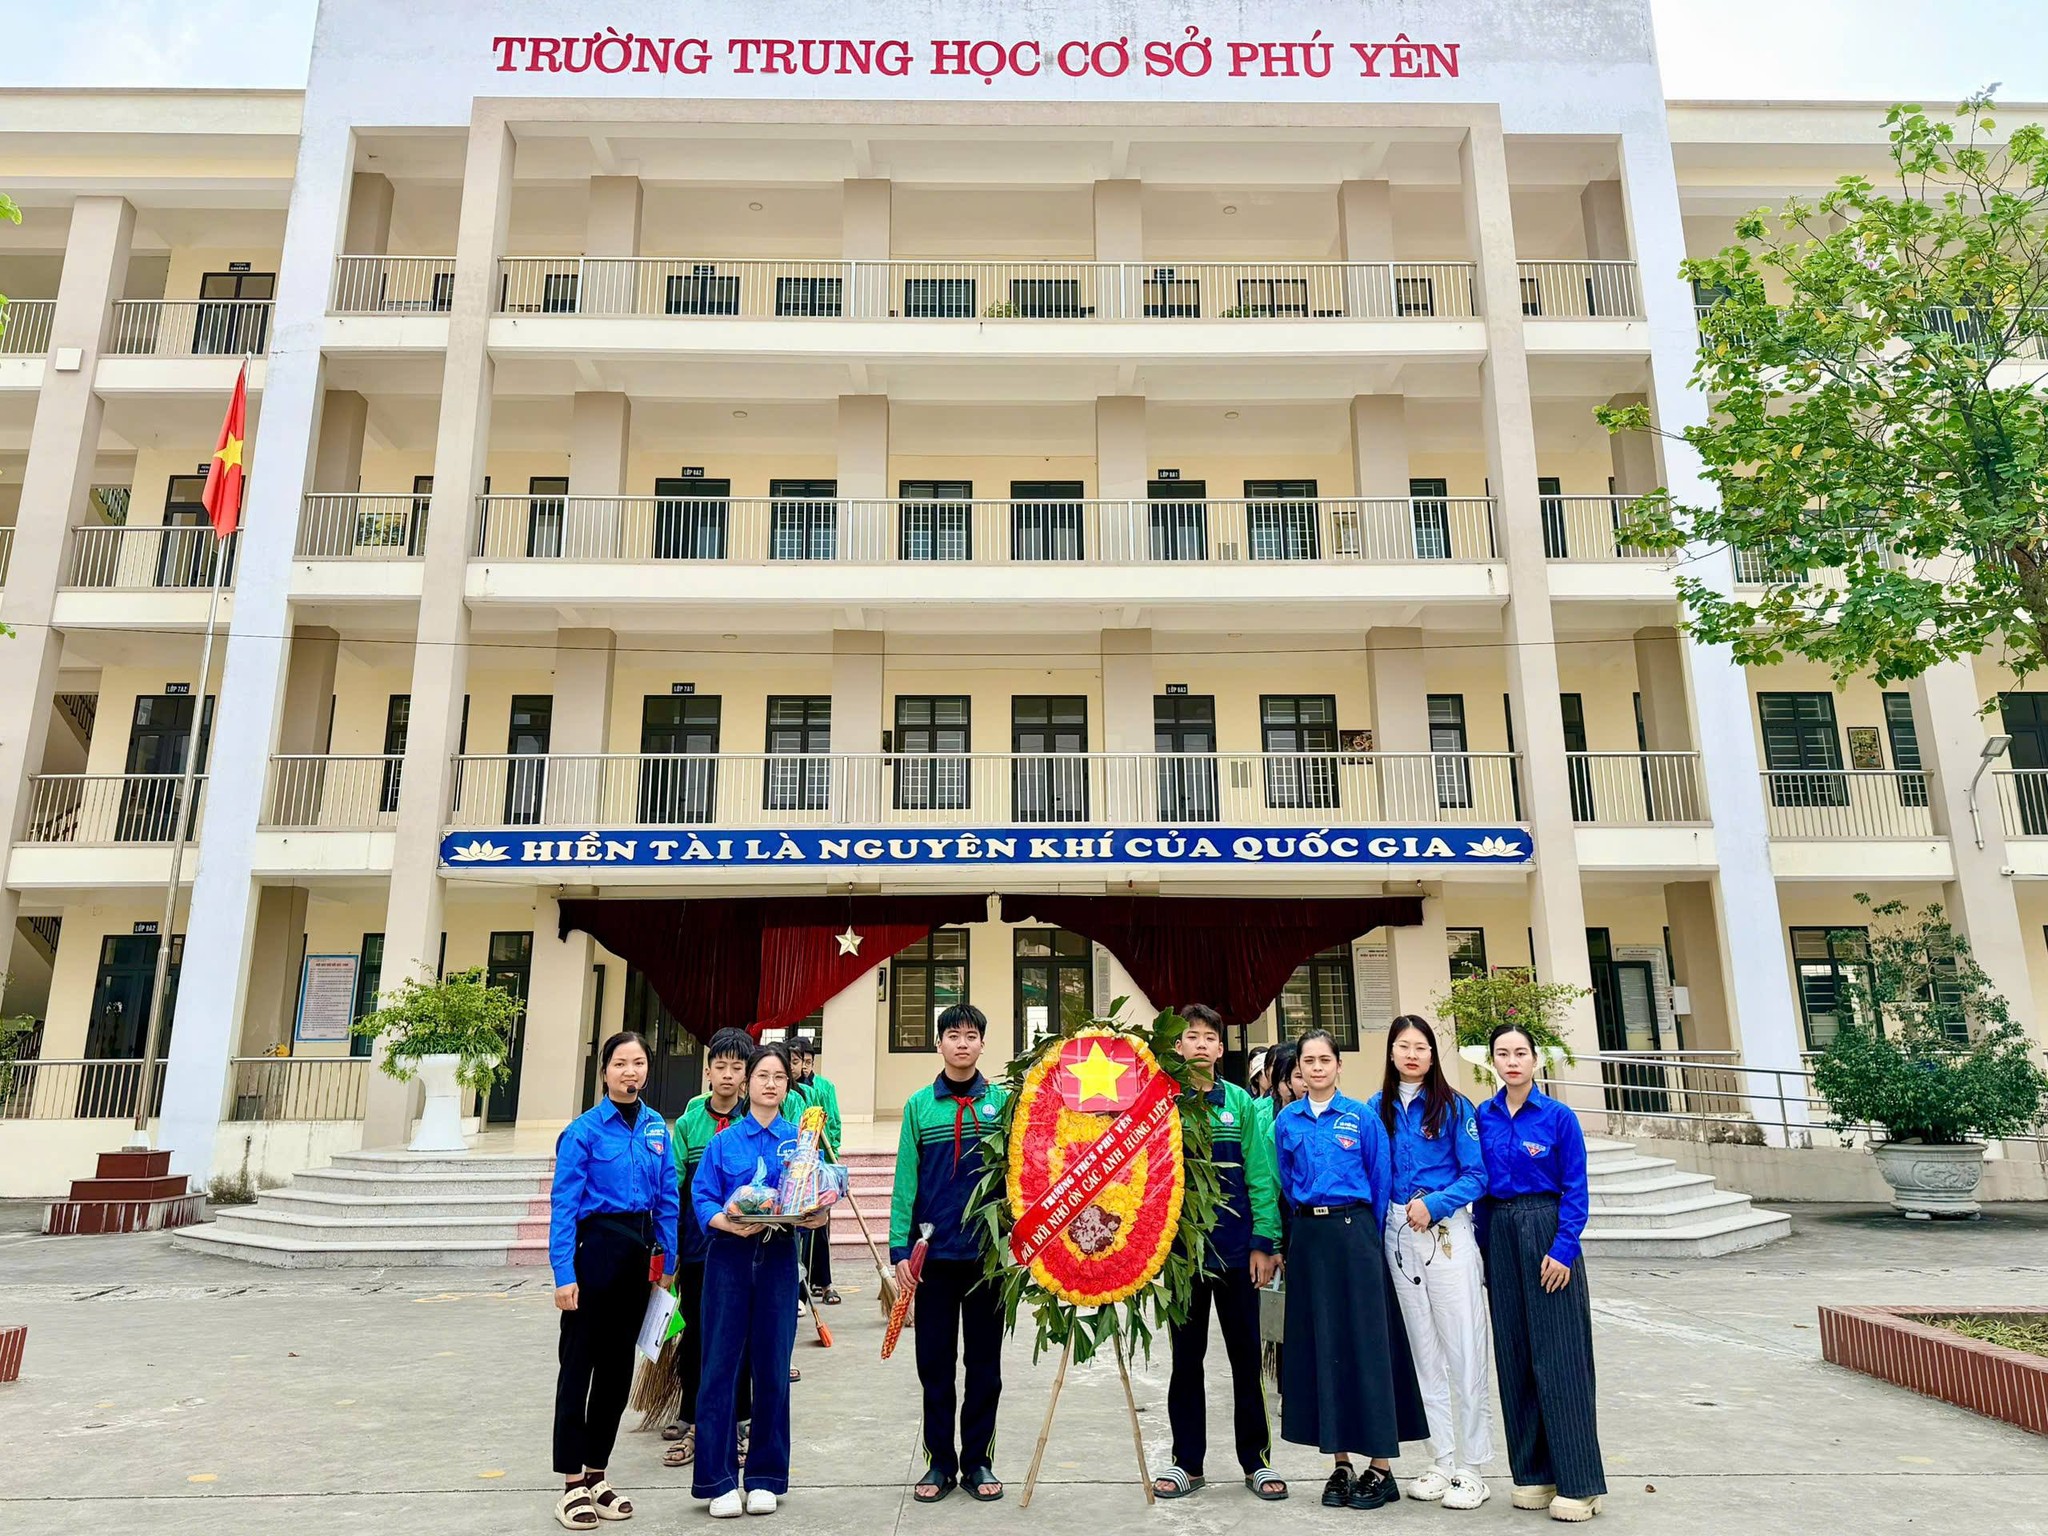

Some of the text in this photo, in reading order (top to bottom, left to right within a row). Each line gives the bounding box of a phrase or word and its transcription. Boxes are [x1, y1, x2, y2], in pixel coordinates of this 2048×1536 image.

[493, 26, 1461, 86] TRƯỜNG TRUNG HỌC CƠ SỞ PHÚ YÊN
[520, 828, 1456, 862] HIỀN TÀI LÀ NGUYÊN KHÍ CỦA QUỐC GIA
[1031, 1223, 1052, 1246] ĐỜI
[1082, 1169, 1103, 1192] CÁC
[1101, 1148, 1125, 1174] ANH
[1123, 1121, 1151, 1152] HÙNG
[1148, 1098, 1170, 1125] LIỆT
[1041, 1113, 1134, 1210] TRƯỜNG THCS PHÚ YÊN
